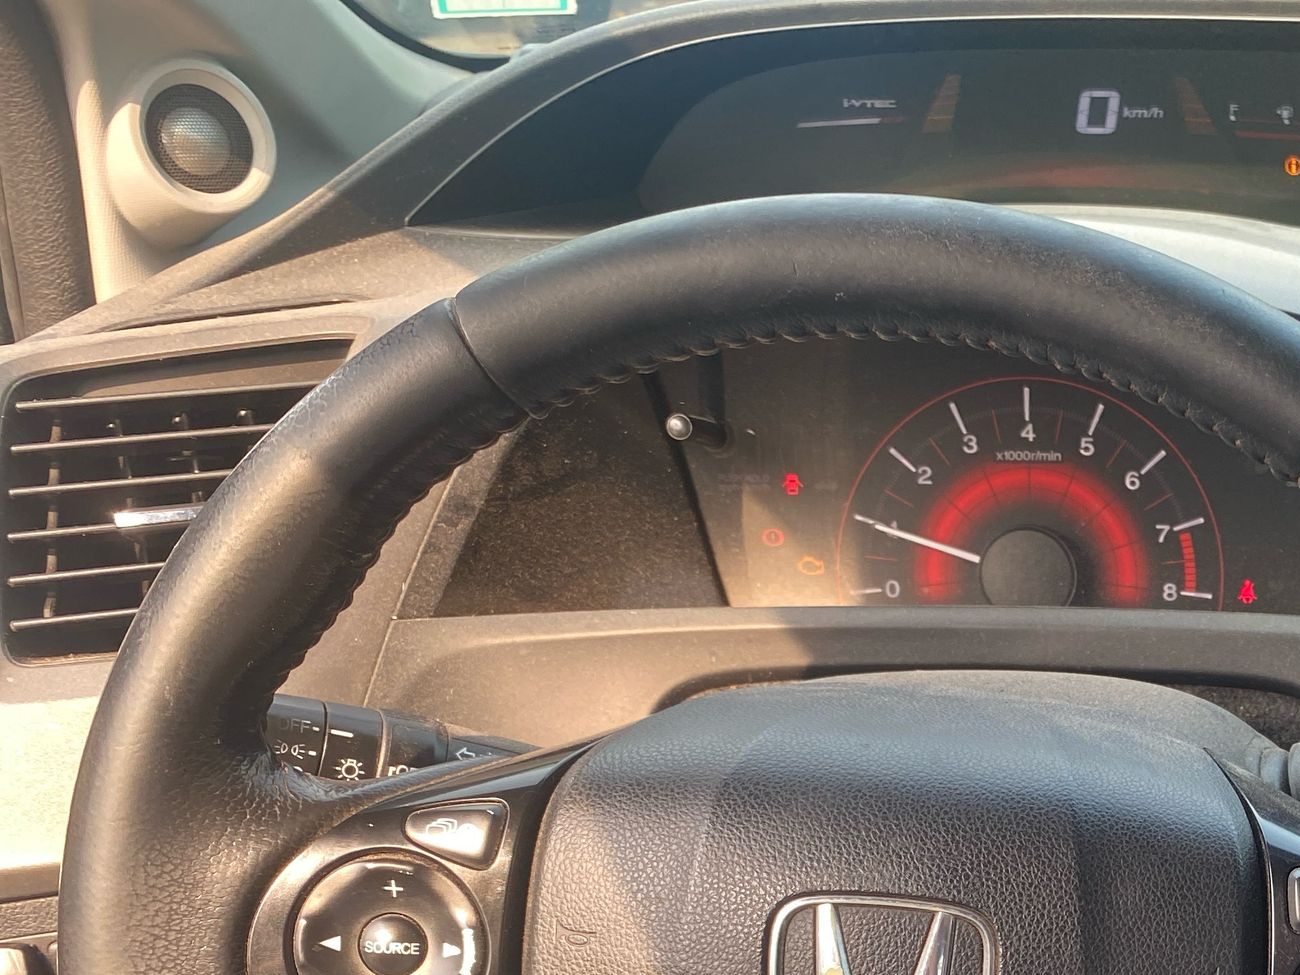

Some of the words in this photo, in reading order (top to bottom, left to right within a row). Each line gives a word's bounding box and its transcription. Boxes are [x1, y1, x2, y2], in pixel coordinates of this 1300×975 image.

[1076, 91, 1121, 135] 0
[1122, 106, 1165, 120] km/h
[1021, 424, 1036, 442] 4
[962, 436, 979, 455] 3
[1080, 437, 1096, 457] 5
[996, 450, 1063, 463] x1000r/min
[916, 467, 934, 486] 2
[1124, 471, 1140, 491] 6
[1156, 524, 1170, 543] 7
[885, 580, 900, 598] 0
[1162, 583, 1178, 601] 8
[364, 939, 421, 956] SOURCE
